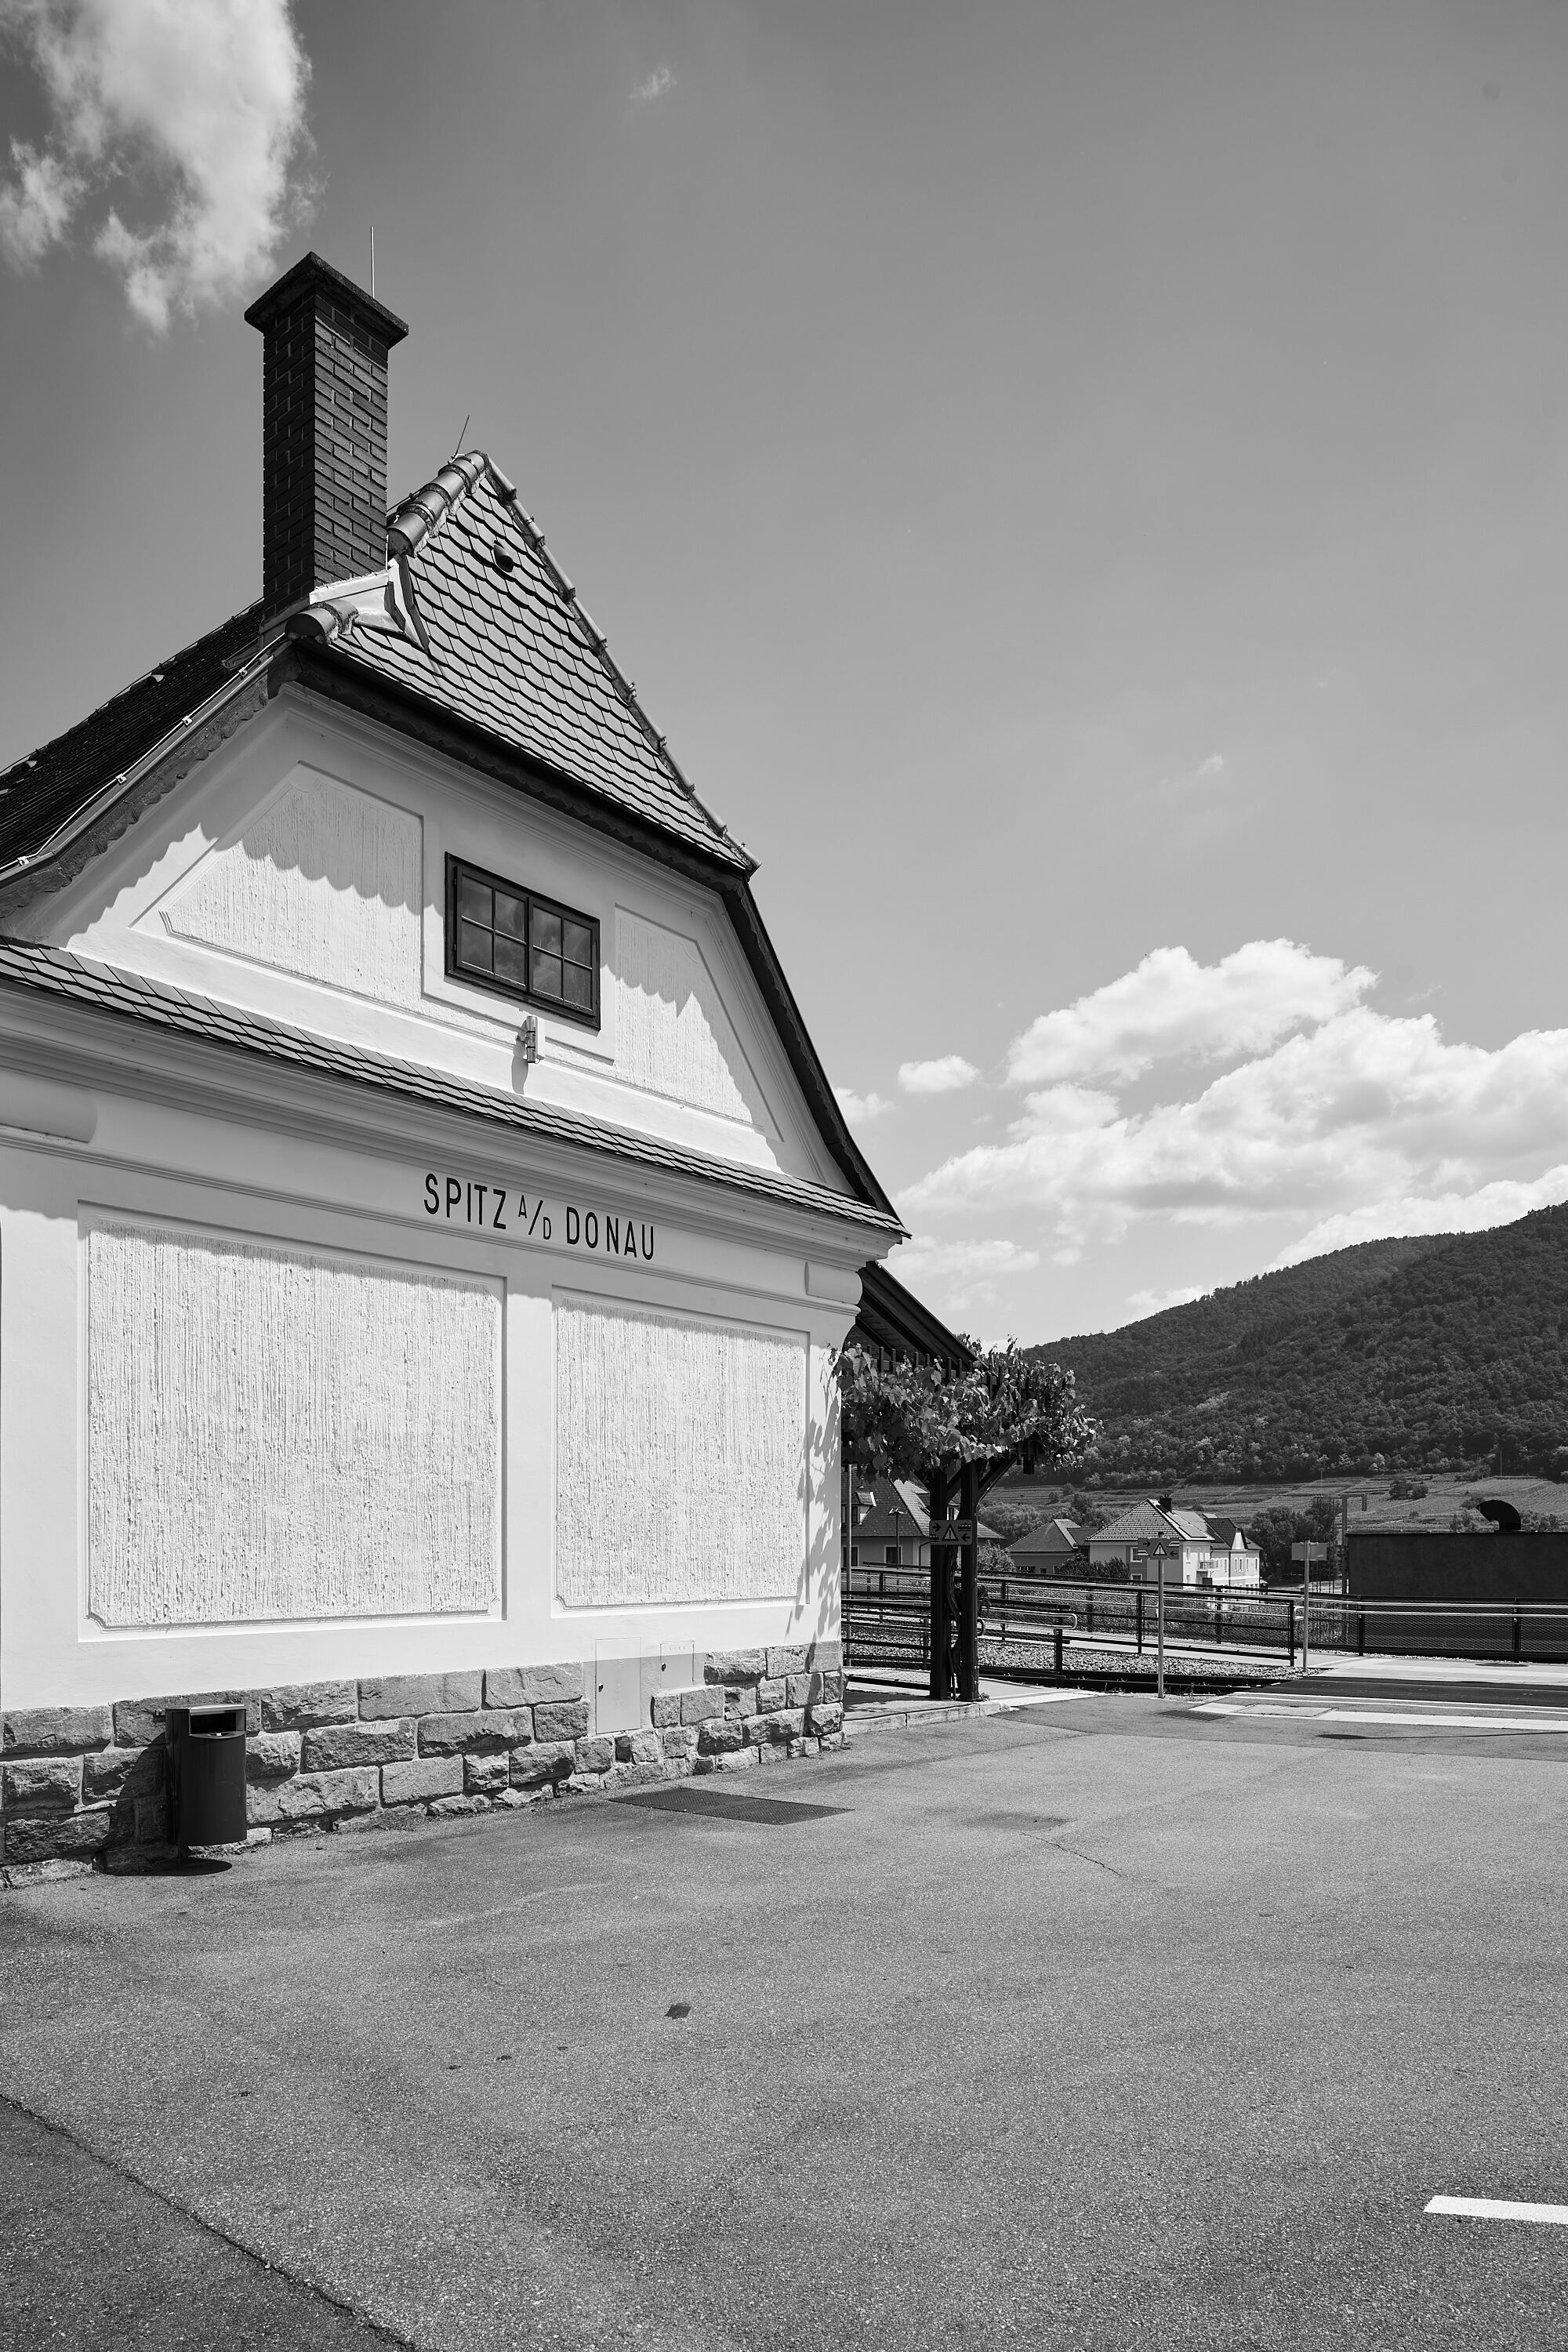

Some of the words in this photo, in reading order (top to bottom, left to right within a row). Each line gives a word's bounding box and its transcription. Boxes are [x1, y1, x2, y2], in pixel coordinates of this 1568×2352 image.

[423, 1173, 507, 1230] SPITZ
[517, 1194, 552, 1240] A/D
[566, 1206, 655, 1261] DONAU
